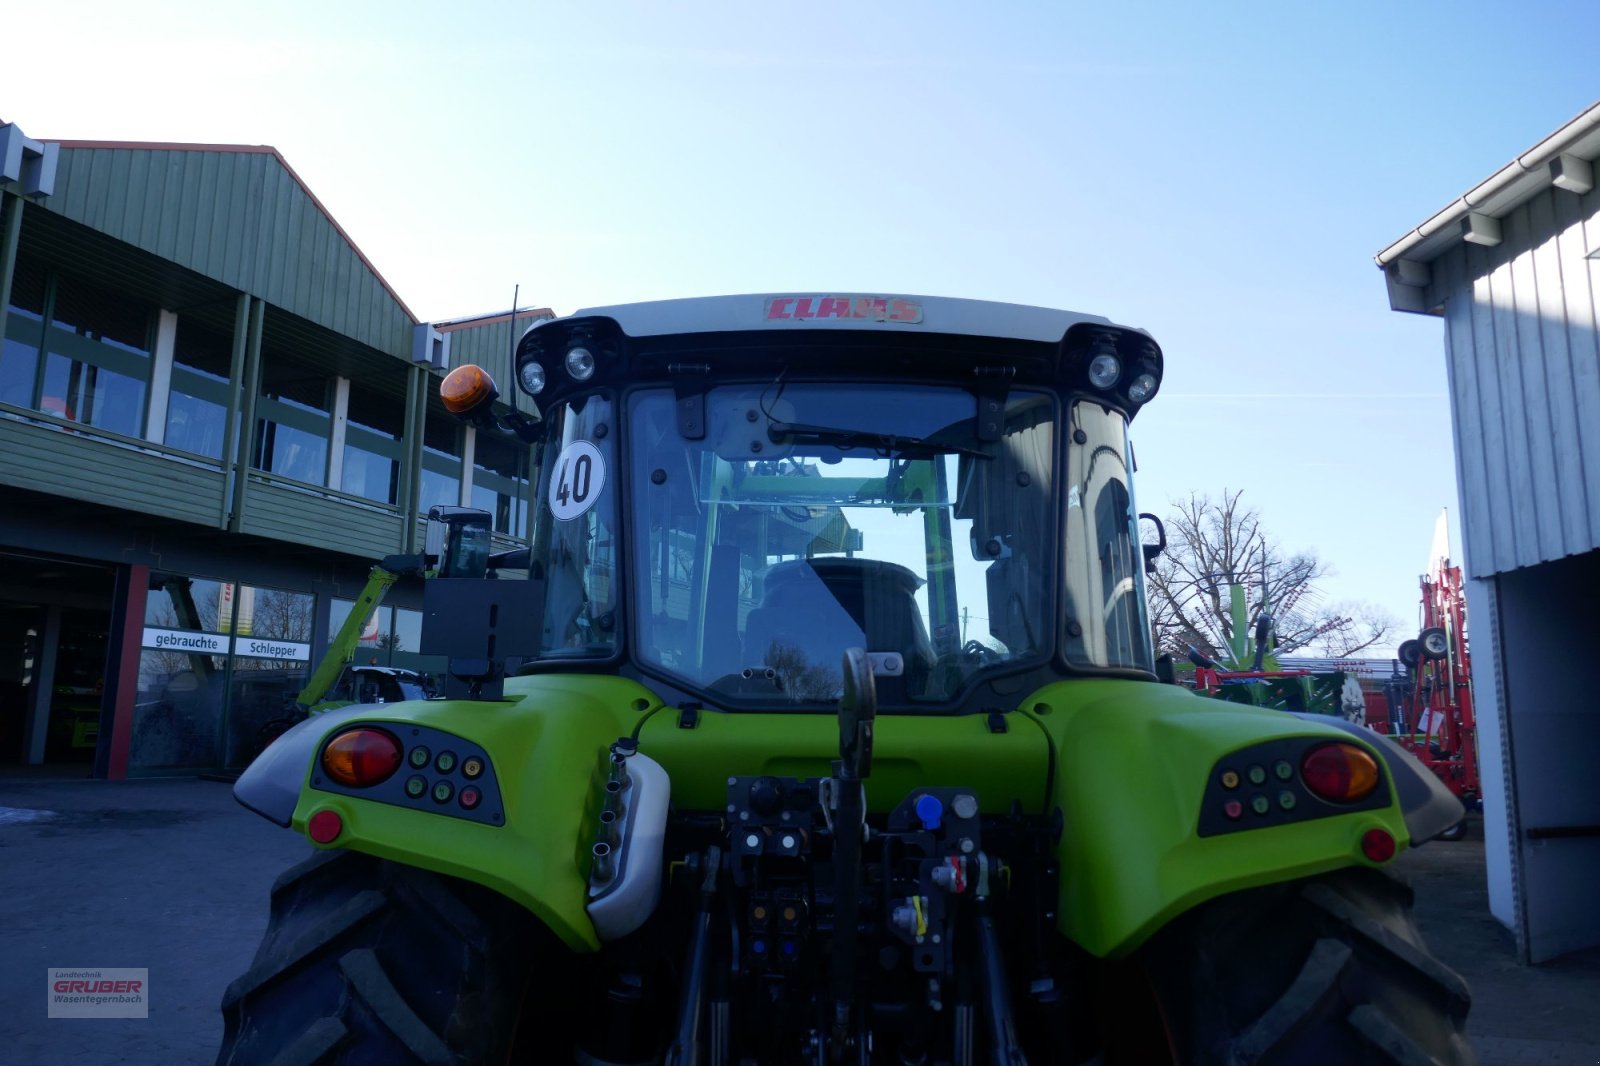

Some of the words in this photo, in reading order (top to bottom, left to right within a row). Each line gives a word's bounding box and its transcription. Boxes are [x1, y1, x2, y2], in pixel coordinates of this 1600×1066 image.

[556, 454, 592, 506] 40
[155, 633, 218, 650] gebrauchte
[250, 642, 297, 658] Schlepper
